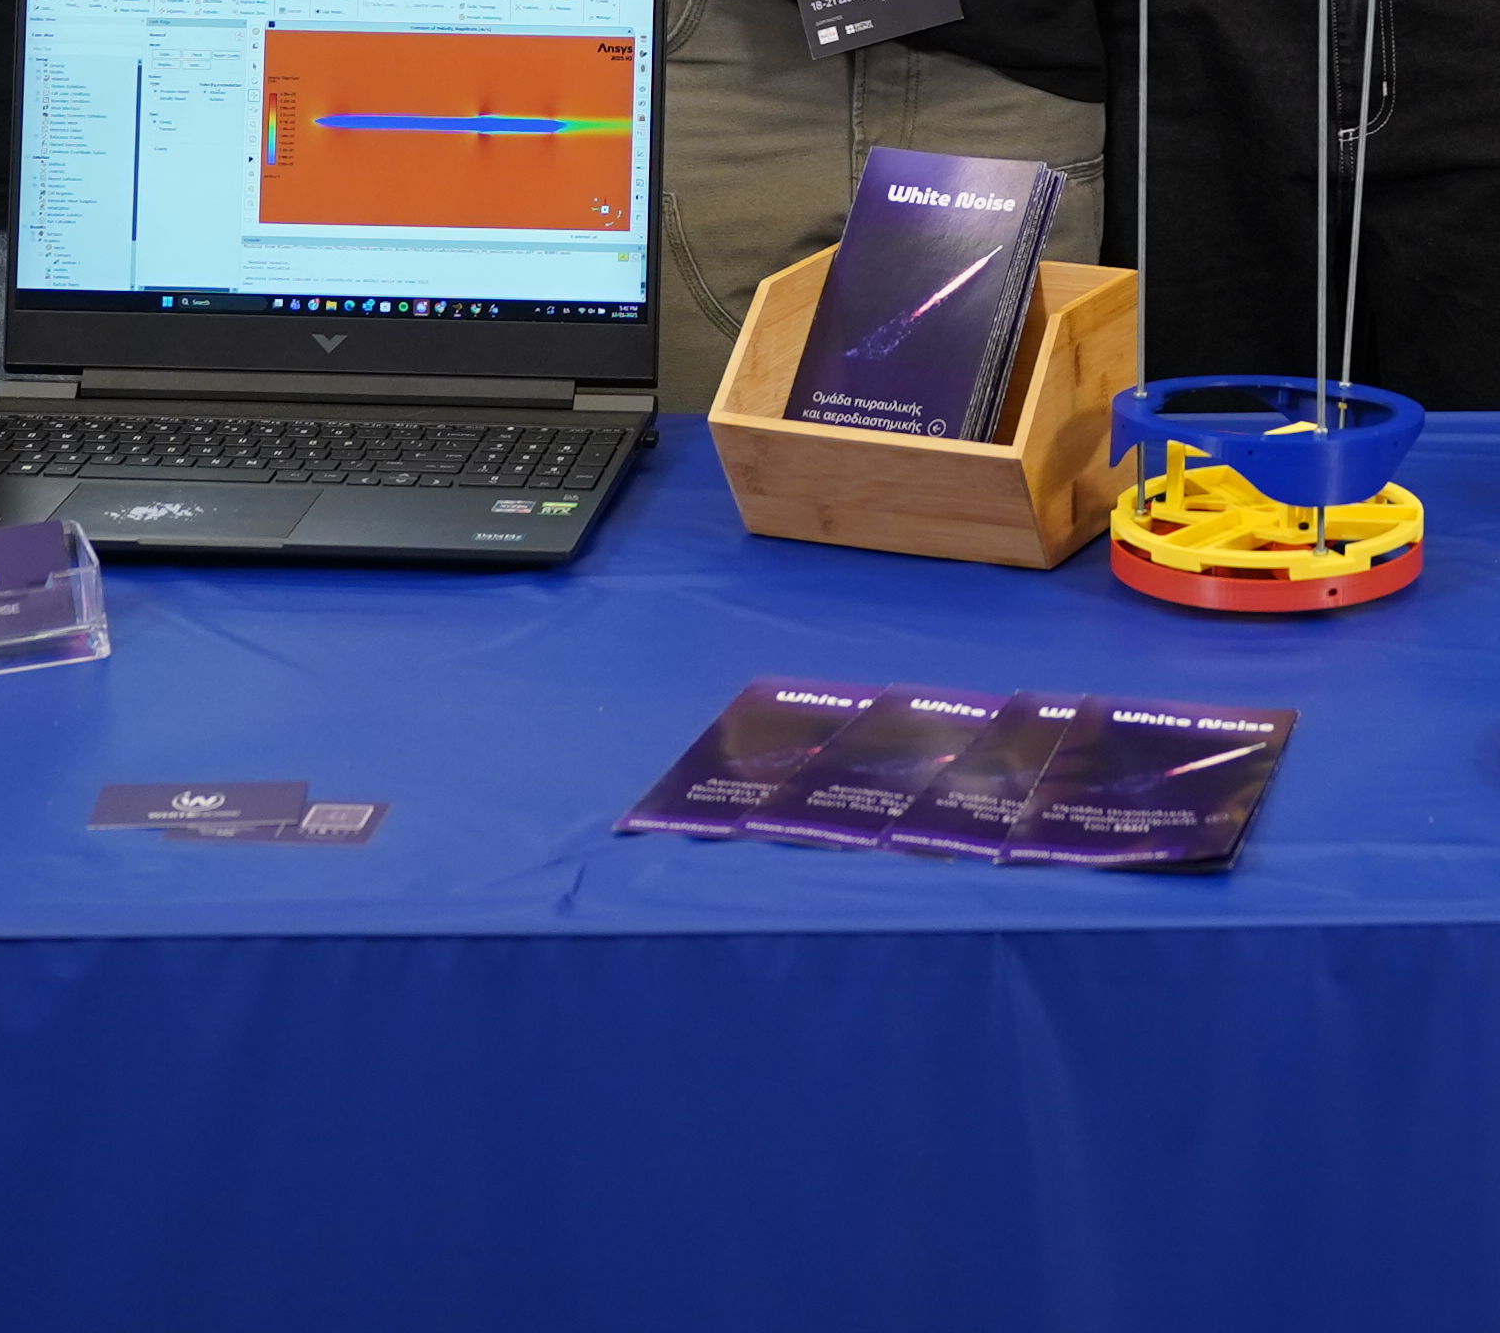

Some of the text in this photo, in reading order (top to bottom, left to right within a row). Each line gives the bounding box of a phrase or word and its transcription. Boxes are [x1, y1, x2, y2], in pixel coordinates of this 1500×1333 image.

[597, 42, 633, 55] Ansys
[887, 184, 1016, 213] White Noise
[812, 390, 923, 417] Ομάδα πυραυλικής
[802, 408, 923, 434] και αεροδιαστημικής
[540, 506, 571, 514] RTX
[775, 690, 853, 707] White
[910, 698, 987, 717] White
[1112, 710, 1274, 732] White Noise
